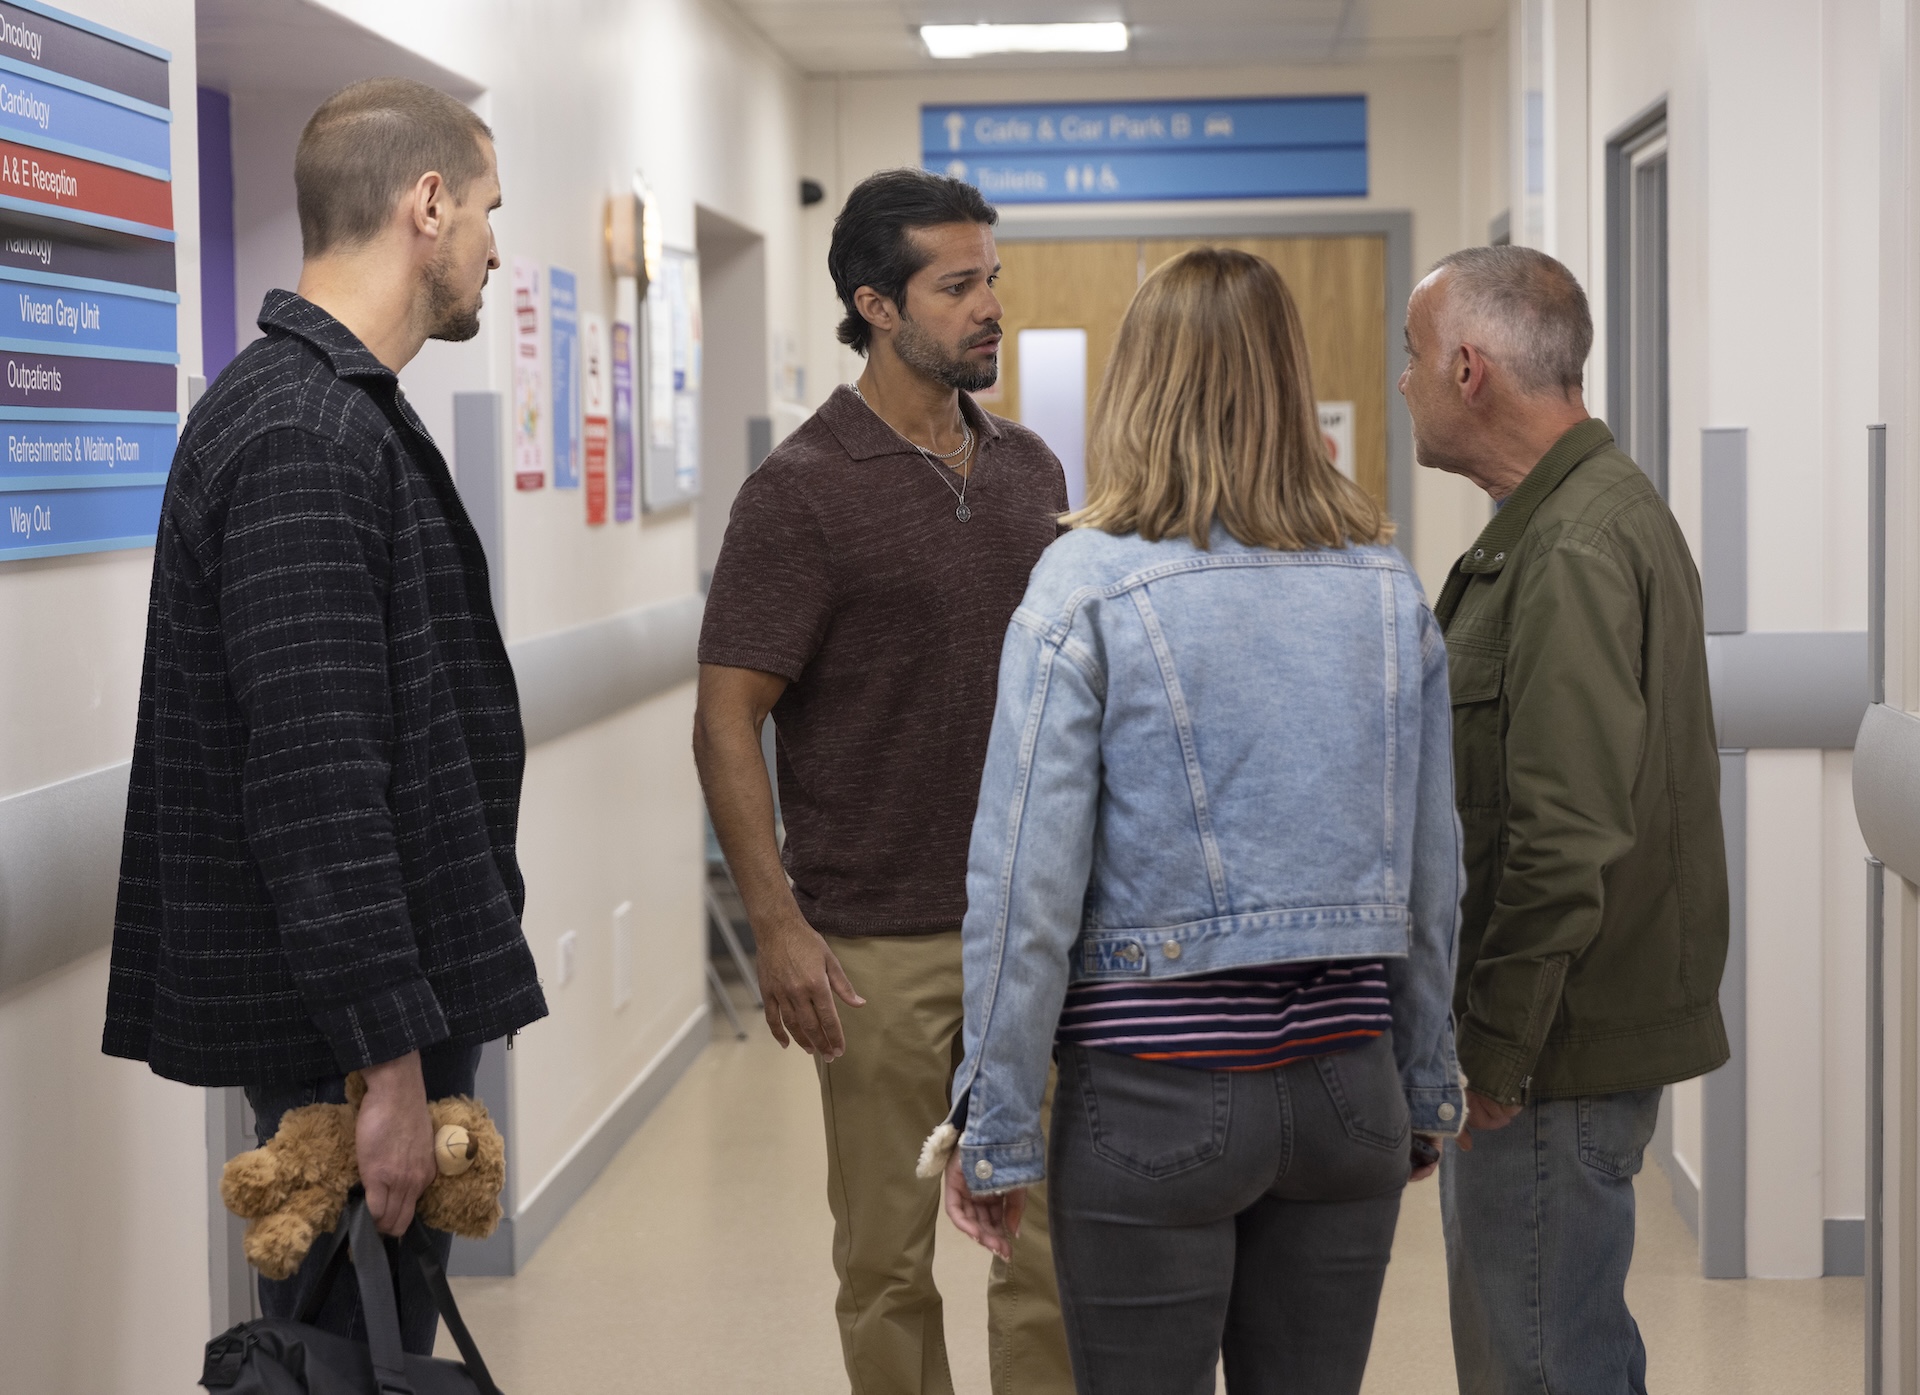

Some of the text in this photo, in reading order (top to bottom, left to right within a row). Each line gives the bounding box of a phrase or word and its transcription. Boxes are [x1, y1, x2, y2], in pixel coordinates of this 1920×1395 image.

[0, 14, 42, 60] Oncology
[0, 83, 50, 129] Cardiology
[975, 116, 1033, 143] Cafe
[1037, 116, 1055, 142] &
[1060, 114, 1103, 141] Car
[1109, 113, 1166, 139] Park
[2, 155, 78, 199] A & E Reception
[977, 167, 1047, 191] Toilets
[19, 293, 100, 334] Vivean Gray Unit
[7, 360, 61, 395] Outpatients
[8, 435, 139, 468] Refreshments & Waiting Room
[9, 504, 51, 539] Way Out
